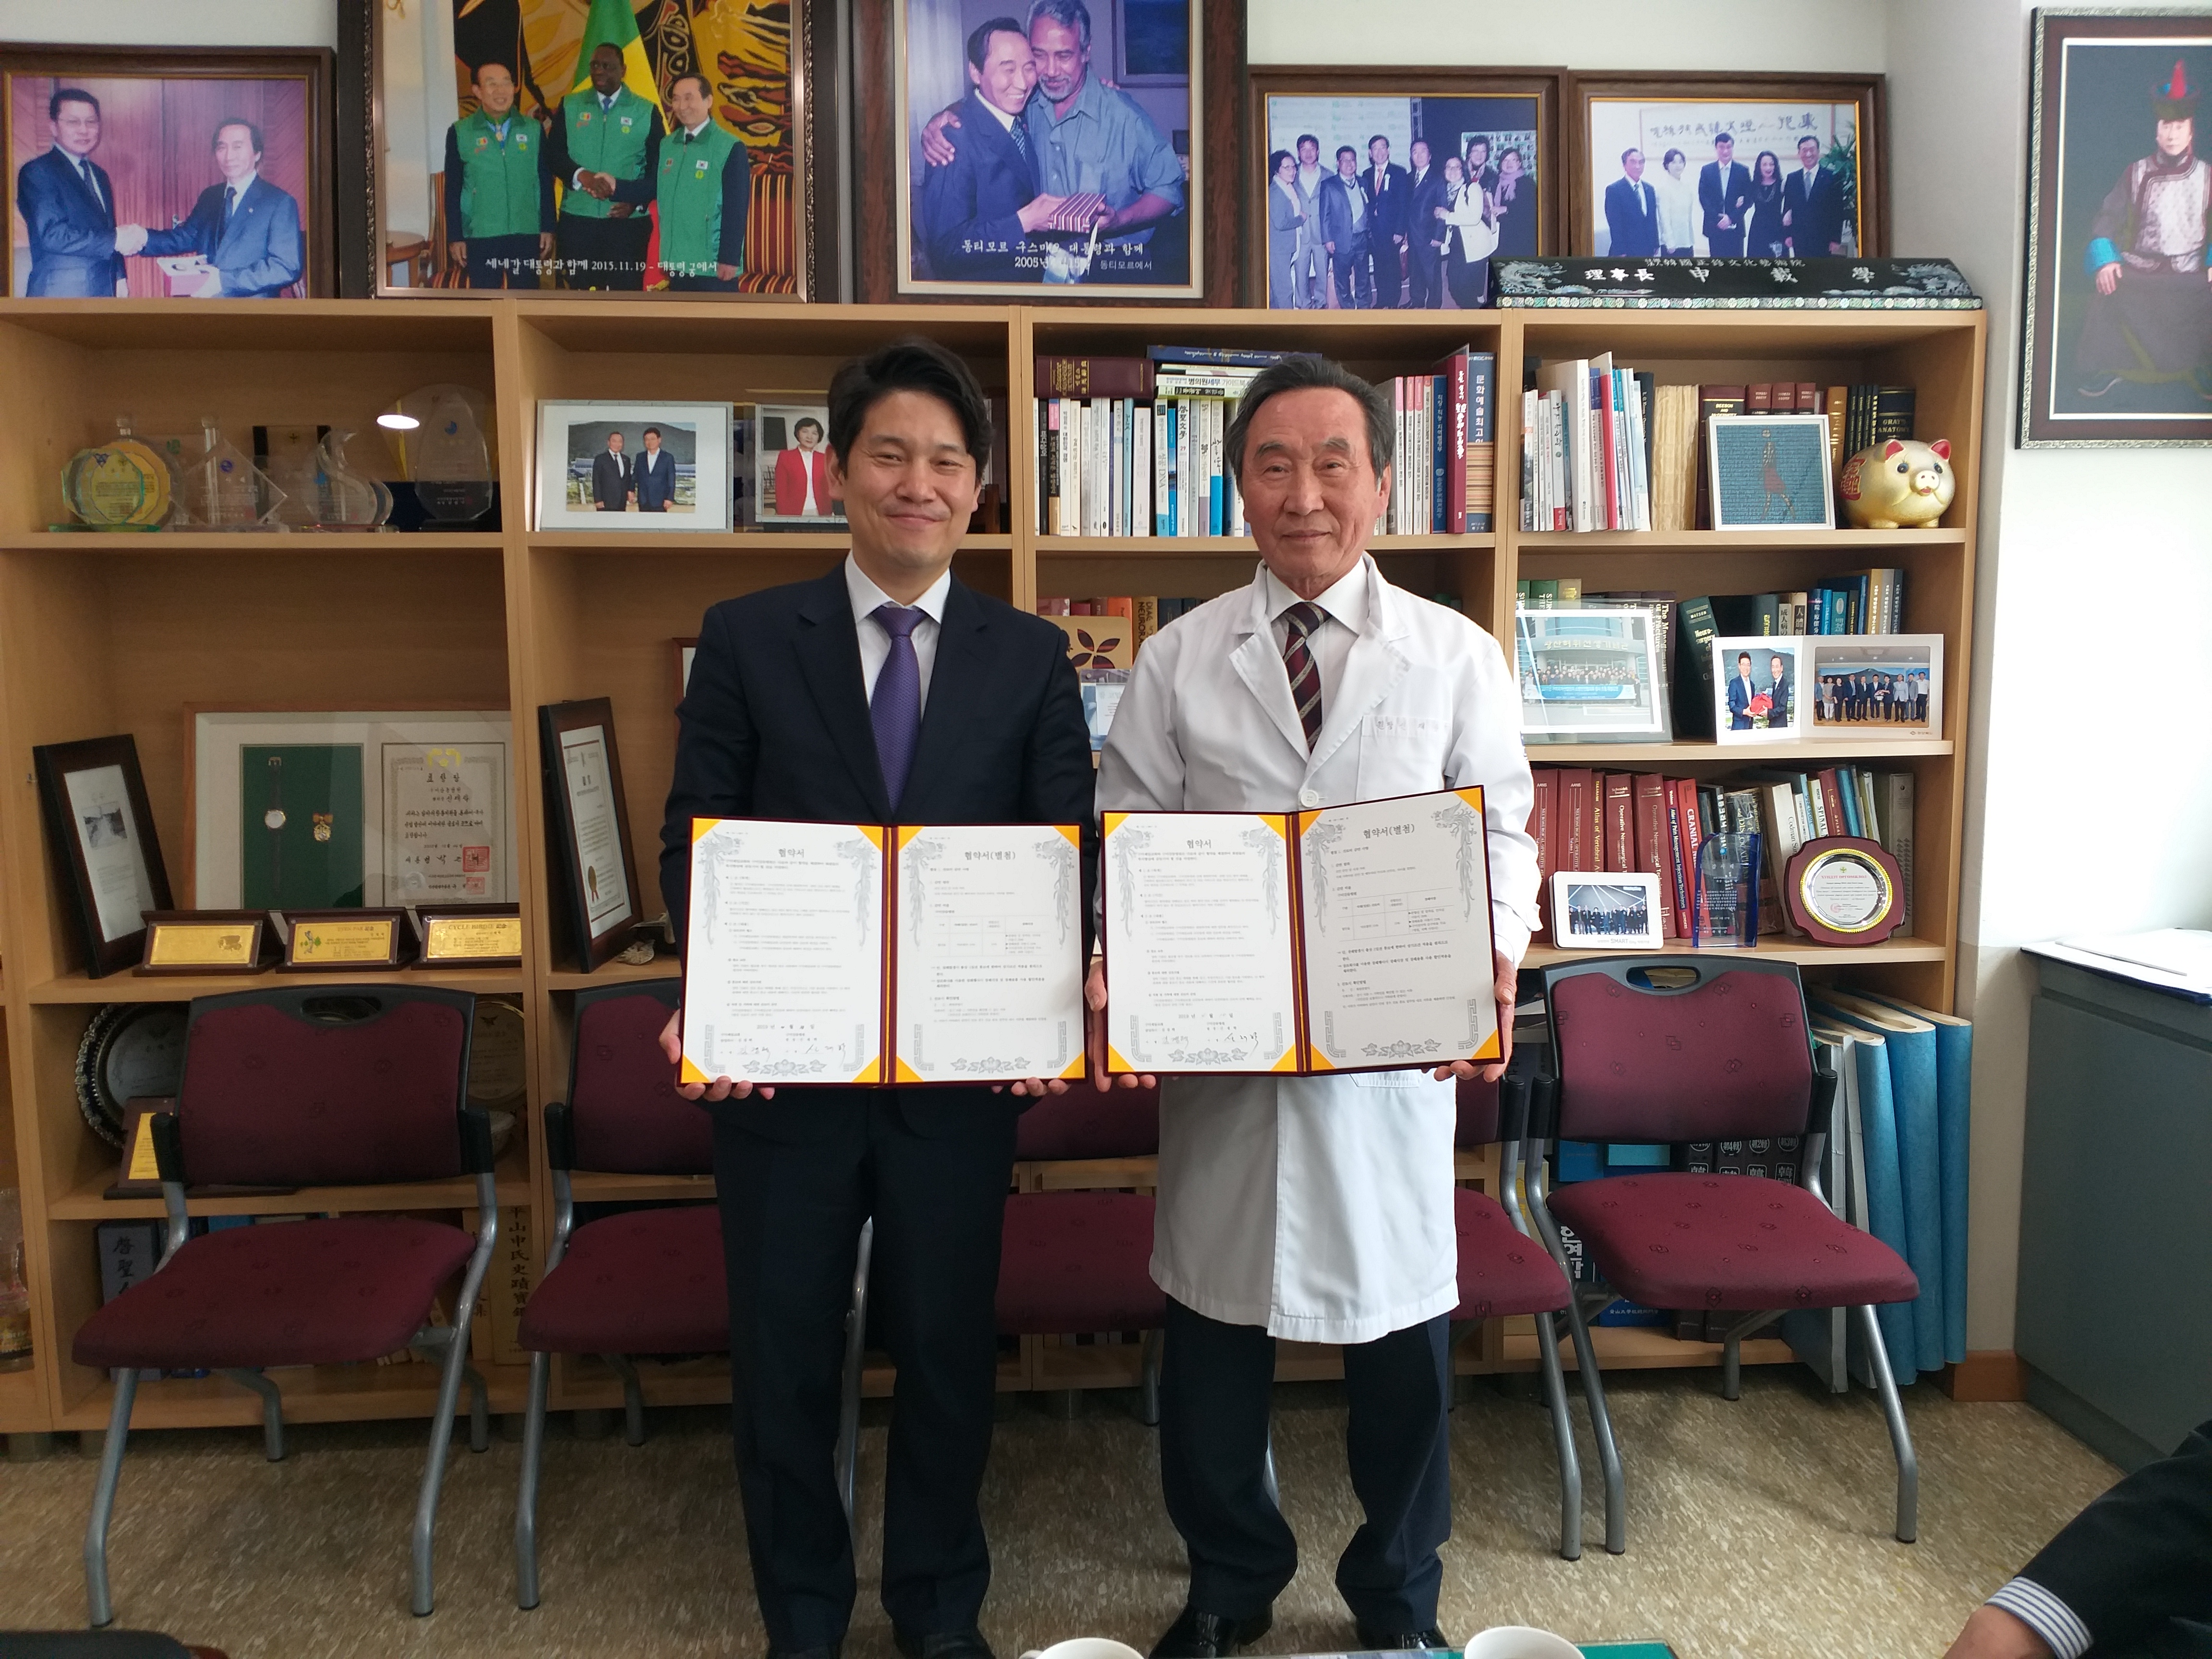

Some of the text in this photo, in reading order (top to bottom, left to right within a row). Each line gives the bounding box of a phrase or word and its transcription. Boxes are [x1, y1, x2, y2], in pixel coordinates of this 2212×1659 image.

[962, 240, 1008, 253] 동티모르
[1069, 241, 1115, 256] 대통령과
[1122, 242, 1143, 256] 함께
[485, 259, 521, 275] 세네갈
[523, 259, 564, 276] 대통령과
[566, 259, 588, 275] 함께
[591, 261, 646, 272] 2015.11.19
[658, 262, 685, 276] 대통령
[689, 262, 717, 276] 궁에서
[1585, 268, 1655, 281] 理事長
[1690, 268, 1710, 283] 申
[1695, 628, 1713, 637] Neuro-
[1696, 634, 1715, 645] surgery
[1817, 806, 1827, 832] SPINAL
[1363, 824, 1415, 839] 협약서(별첨)
[1687, 808, 1697, 849] CRANIAL
[1187, 839, 1212, 849] 협약서
[779, 848, 805, 858] 협약서
[965, 851, 1015, 861] 협약서(별첨)
[113, 1236, 134, 1295] 啓聖
